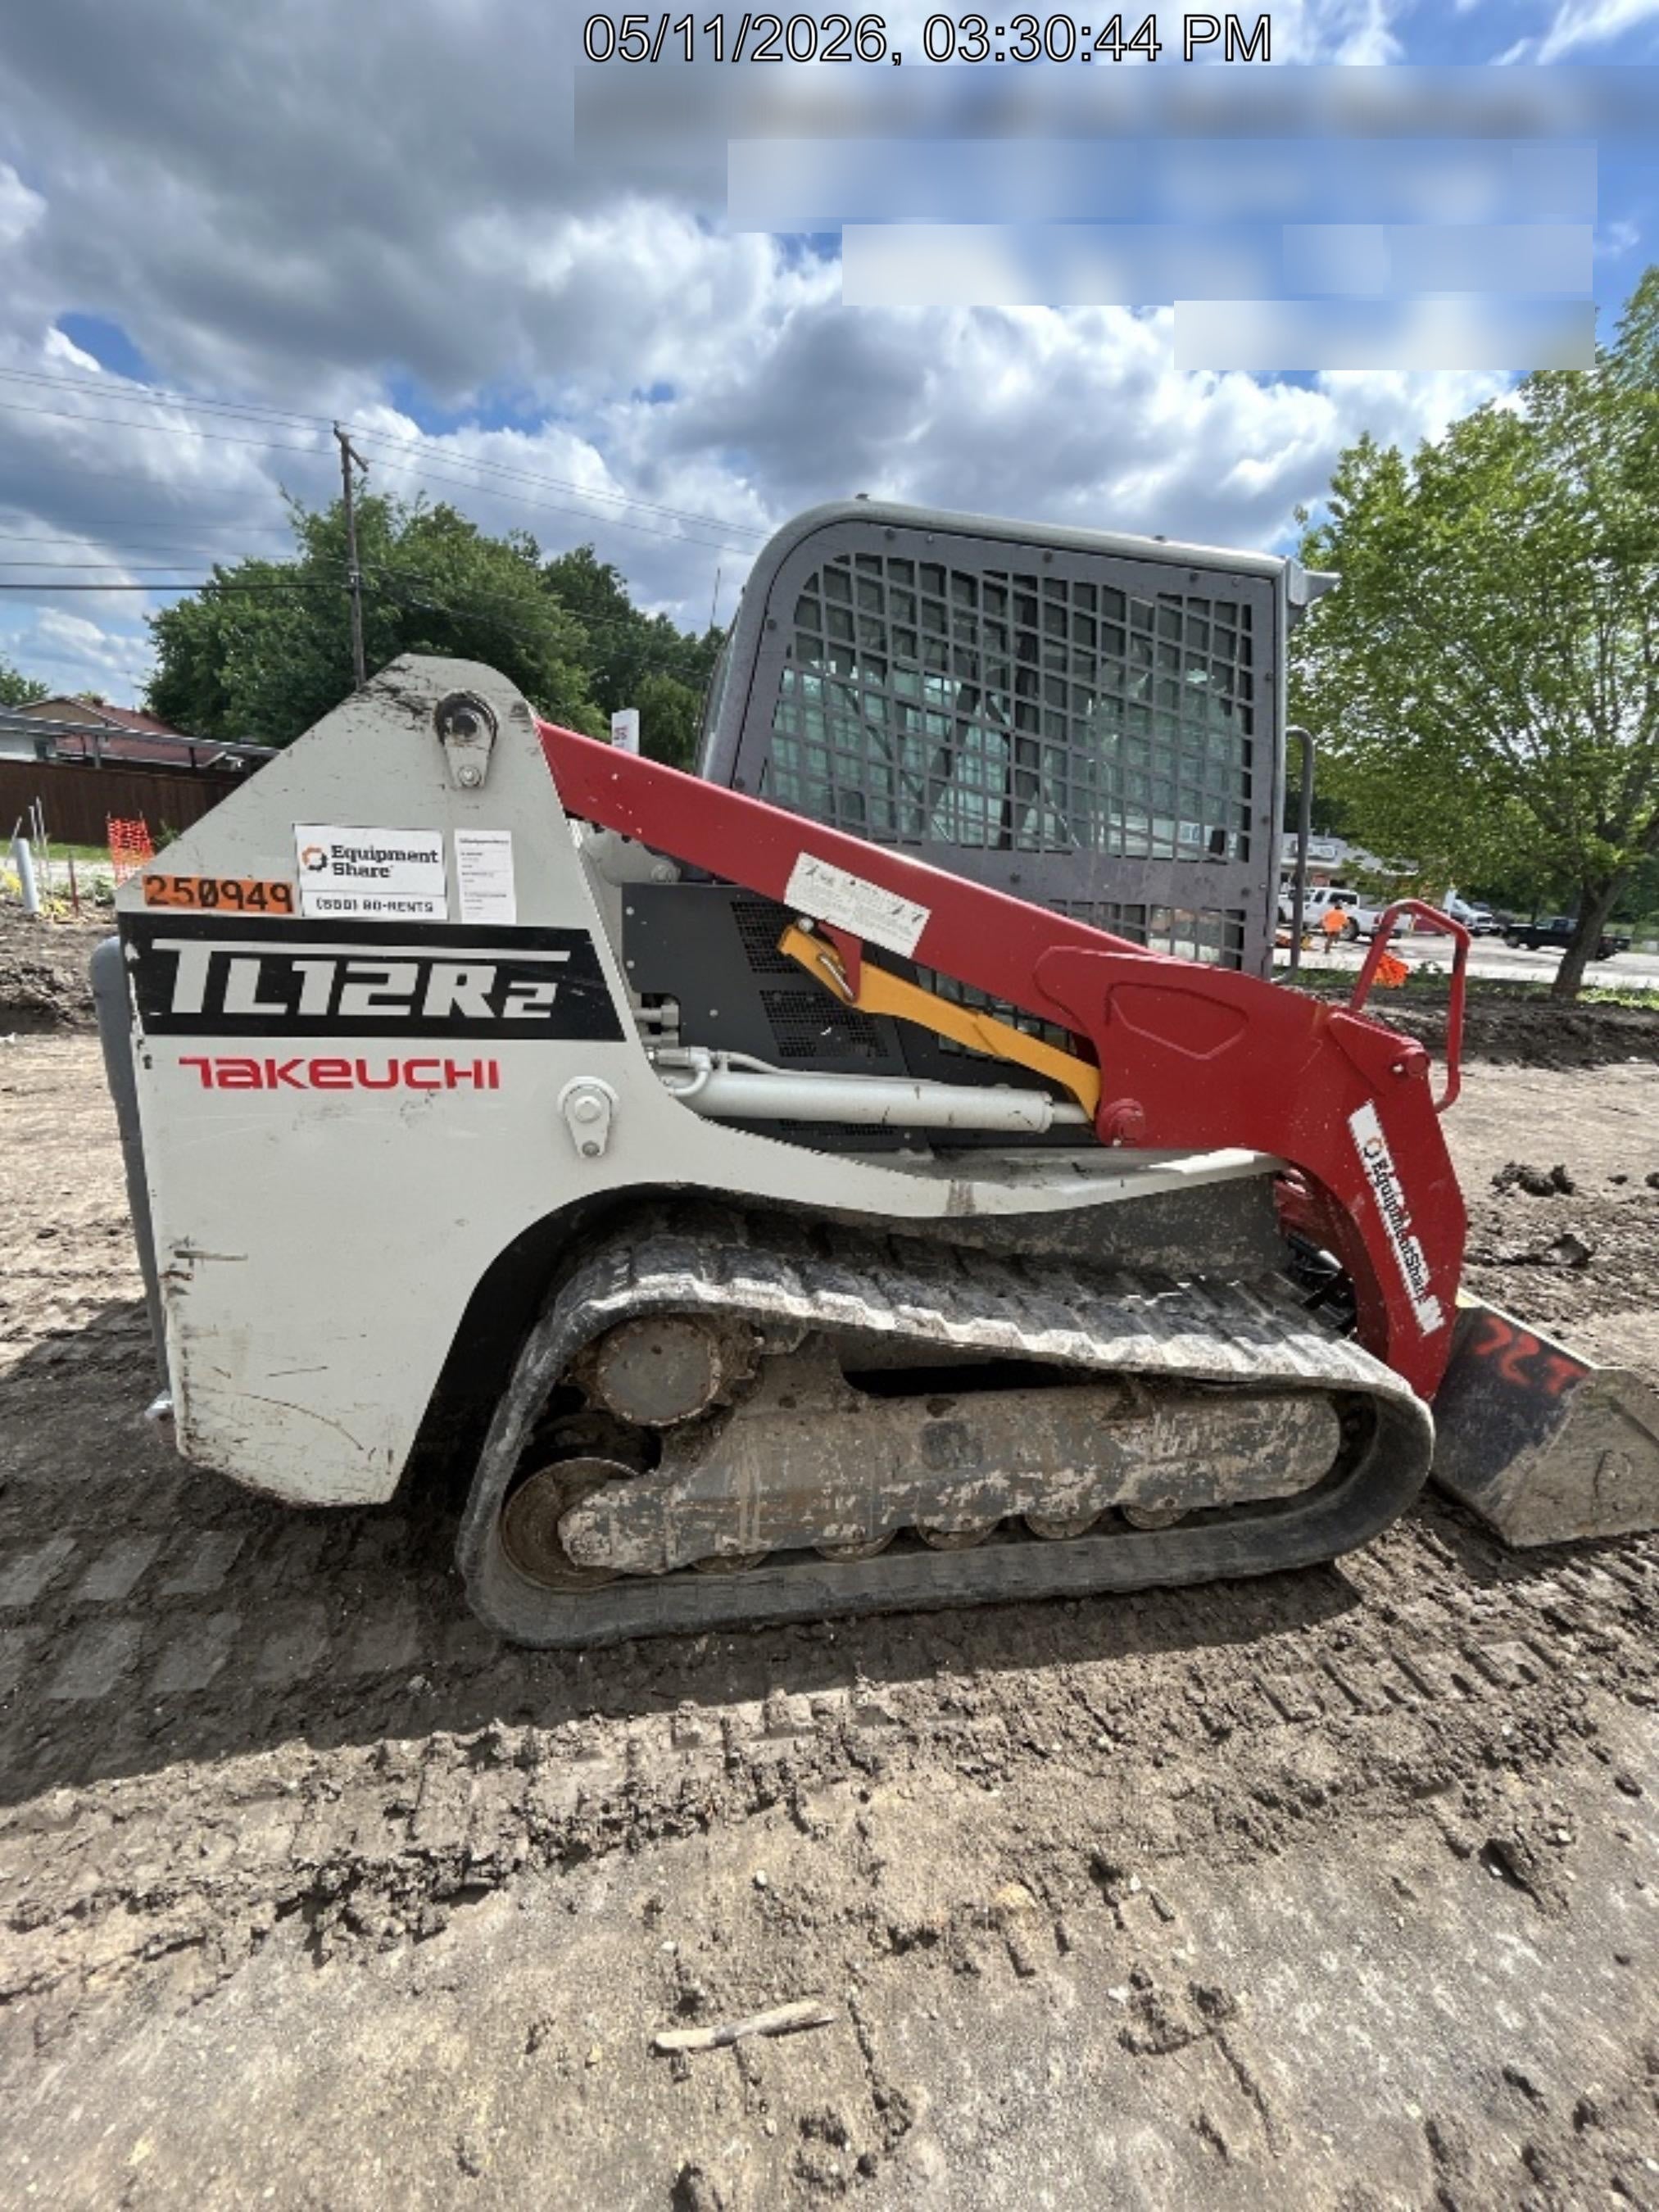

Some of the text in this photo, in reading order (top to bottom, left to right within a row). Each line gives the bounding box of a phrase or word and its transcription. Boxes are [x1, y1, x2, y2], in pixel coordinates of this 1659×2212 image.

[330, 844, 439, 864] Equipment
[332, 862, 392, 878] Share
[145, 874, 293, 913] 250949
[152, 939, 572, 1018] TL12R2
[178, 1057, 501, 1090] TAKEUCHI
